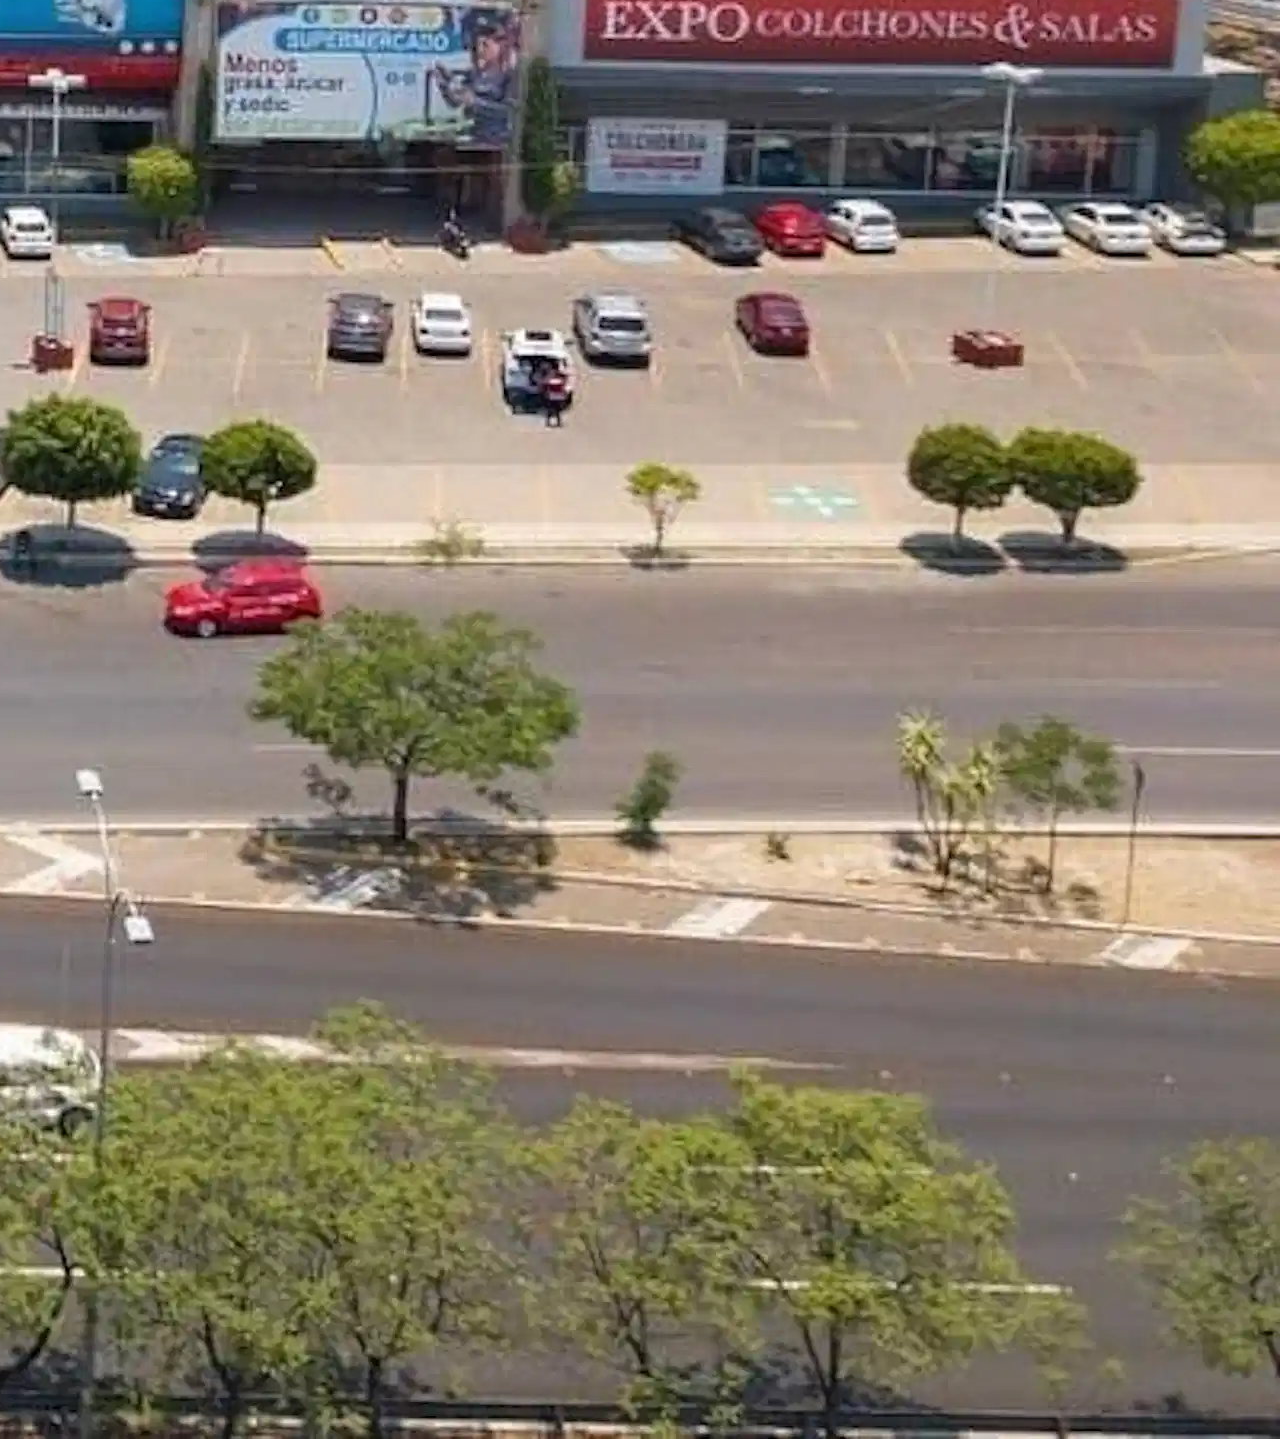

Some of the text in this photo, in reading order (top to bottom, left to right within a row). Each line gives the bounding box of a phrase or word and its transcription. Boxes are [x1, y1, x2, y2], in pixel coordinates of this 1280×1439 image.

[601, 0, 1158, 50] EXPO COLCHONES & SALAS
